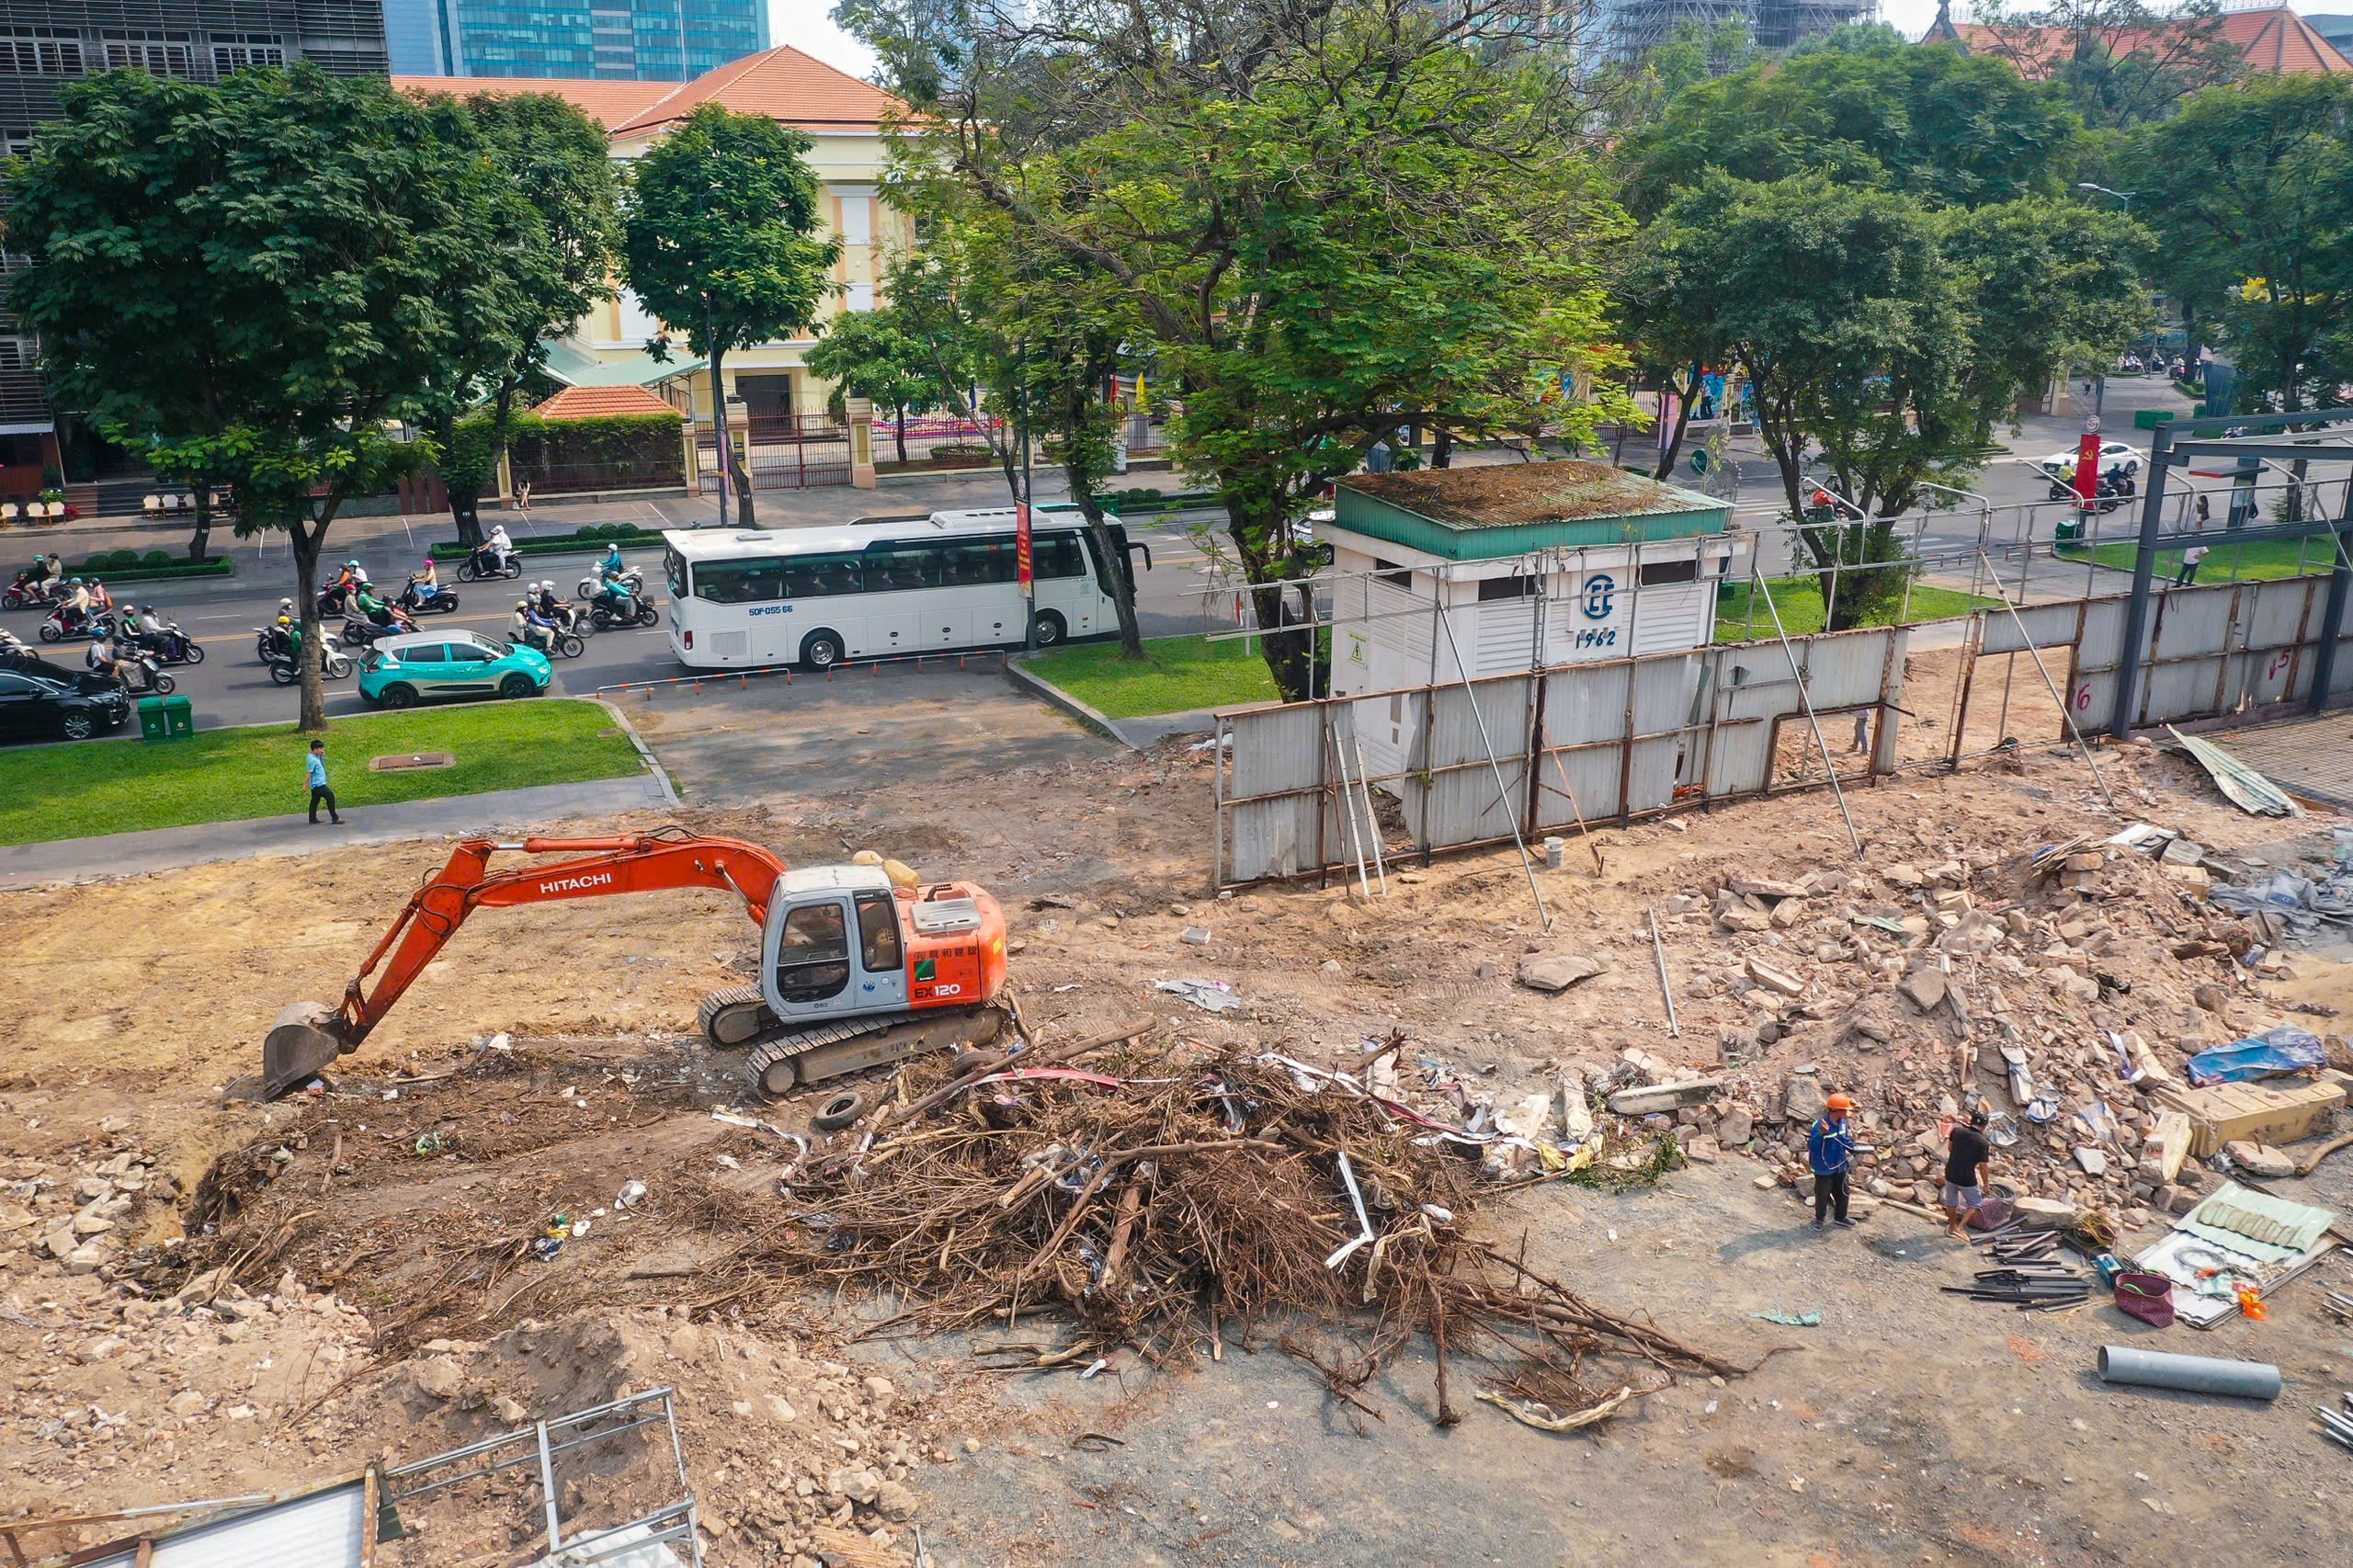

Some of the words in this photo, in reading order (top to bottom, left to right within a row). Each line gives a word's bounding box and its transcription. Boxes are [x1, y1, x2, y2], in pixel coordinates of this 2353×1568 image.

[1575, 631, 1616, 649] 1962
[2278, 648, 2291, 669] 5
[2076, 683, 2092, 711] 6
[540, 873, 612, 893] HITACHI
[915, 983, 961, 999] EX120
